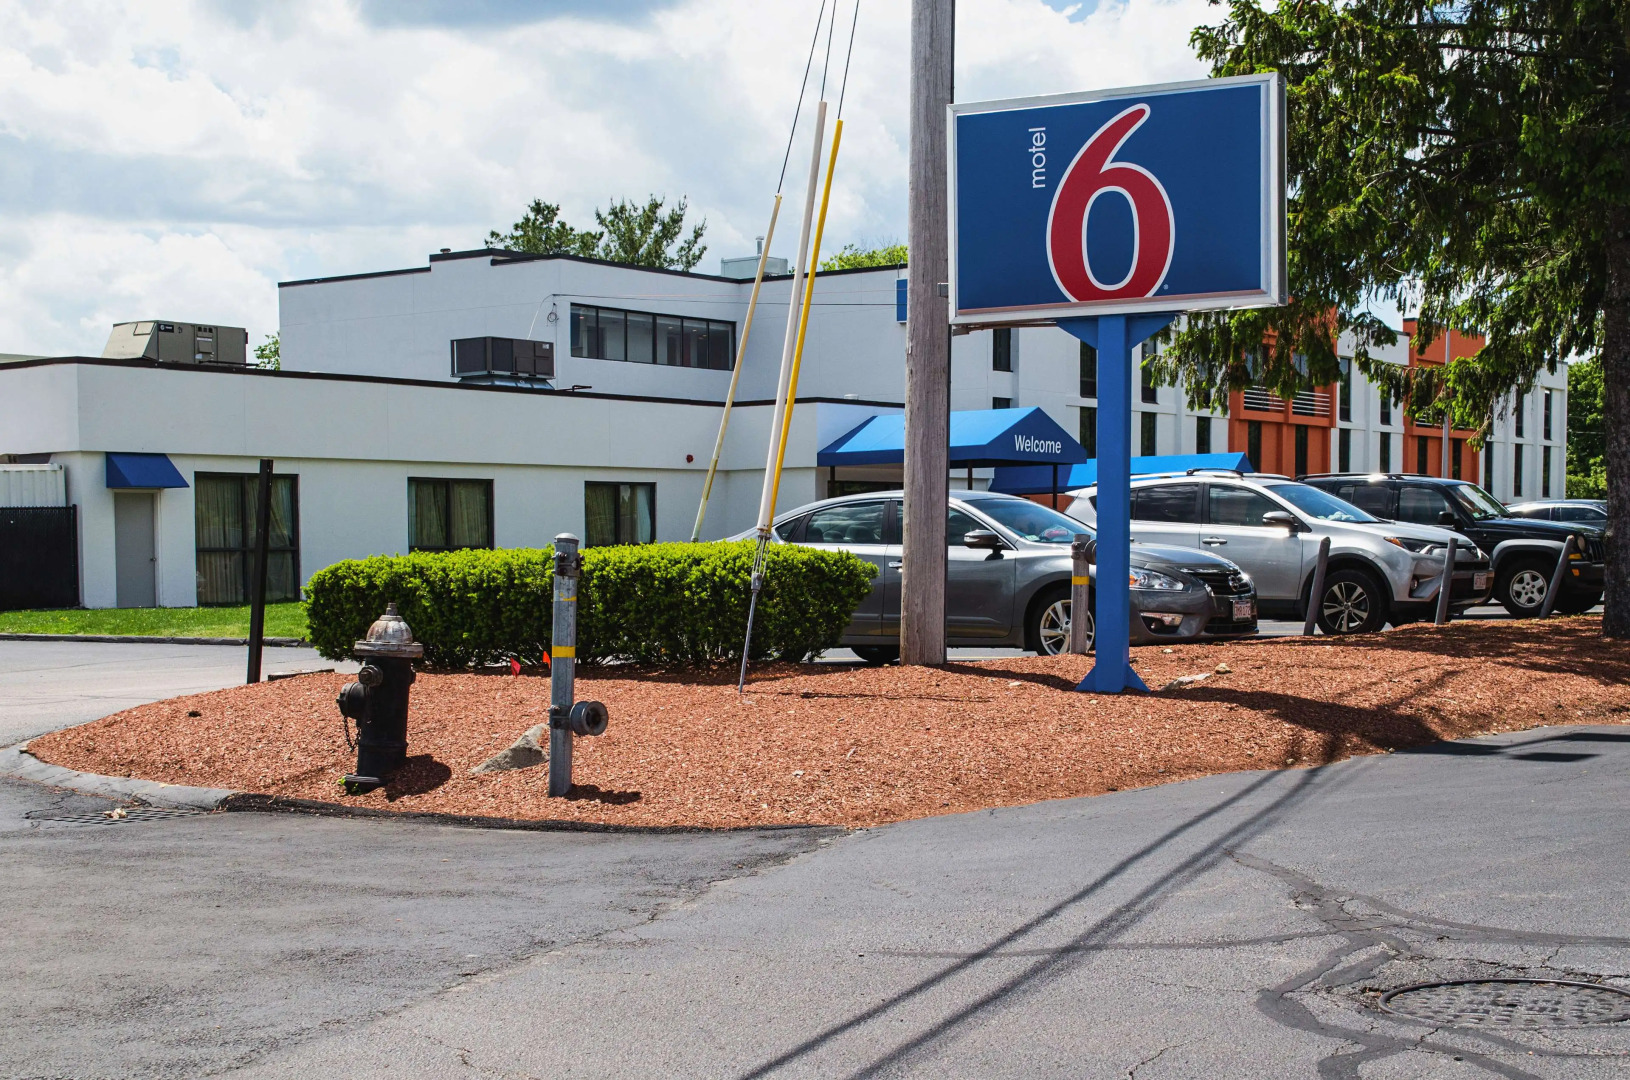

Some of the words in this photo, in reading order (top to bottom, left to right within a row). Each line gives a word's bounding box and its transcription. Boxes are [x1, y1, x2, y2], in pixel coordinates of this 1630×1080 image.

[1028, 127, 1046, 188] motel
[1046, 103, 1175, 302] 6
[1014, 434, 1062, 454] Welcome
